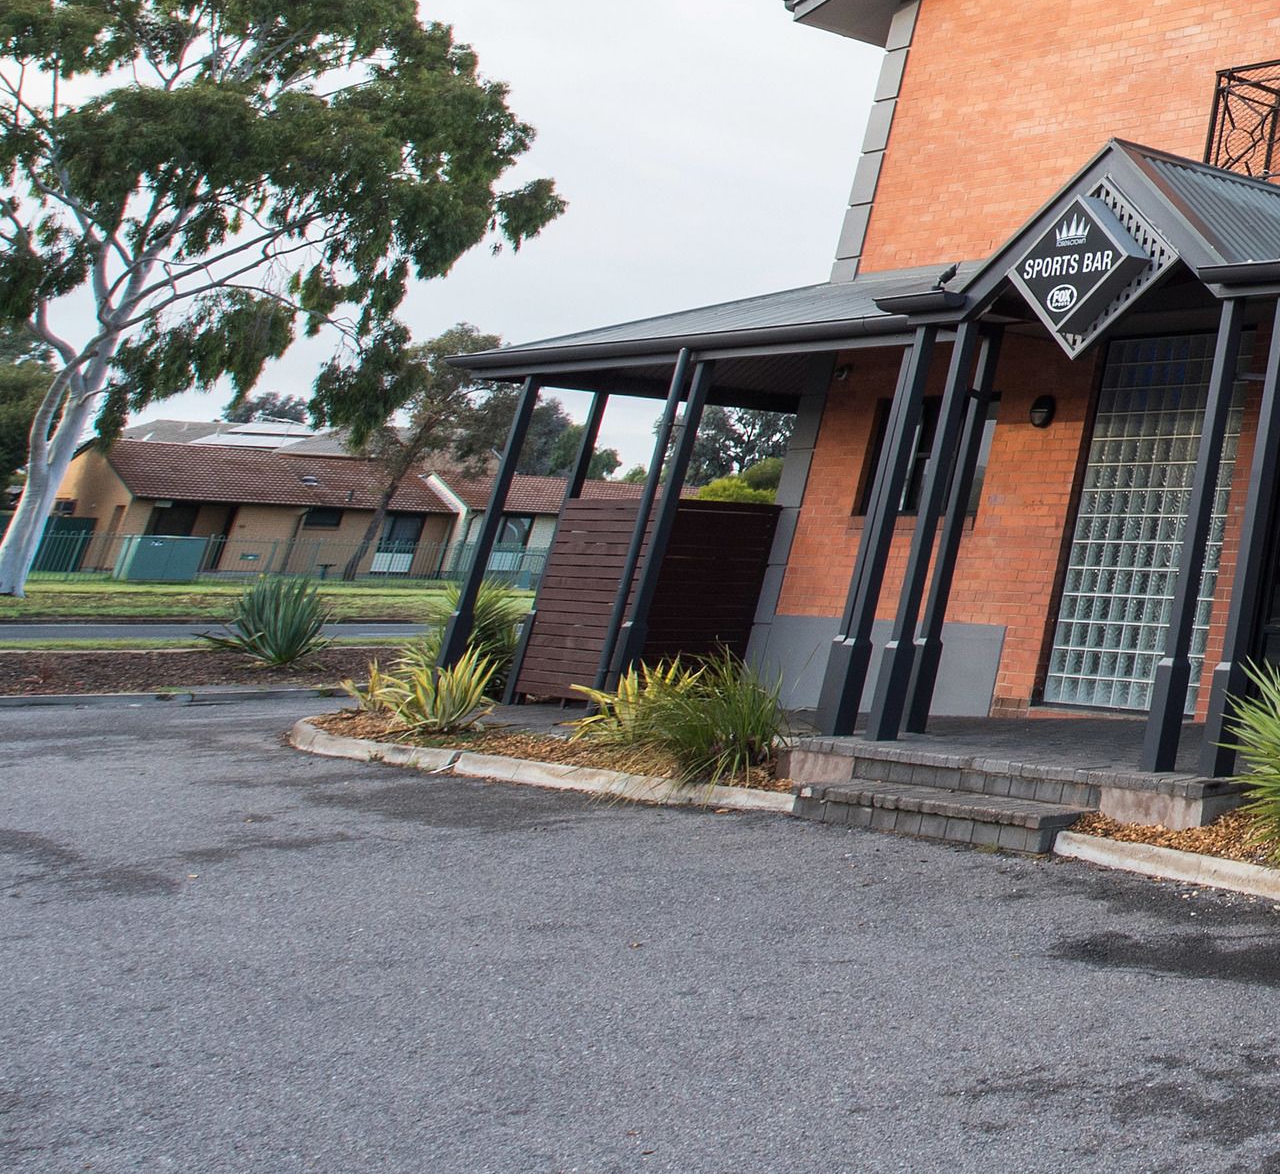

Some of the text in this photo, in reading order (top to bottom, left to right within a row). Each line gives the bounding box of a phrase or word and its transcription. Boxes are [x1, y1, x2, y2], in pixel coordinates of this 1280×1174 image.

[1023, 250, 1113, 280] SPORTS BAR
[1053, 289, 1072, 302] FOX
